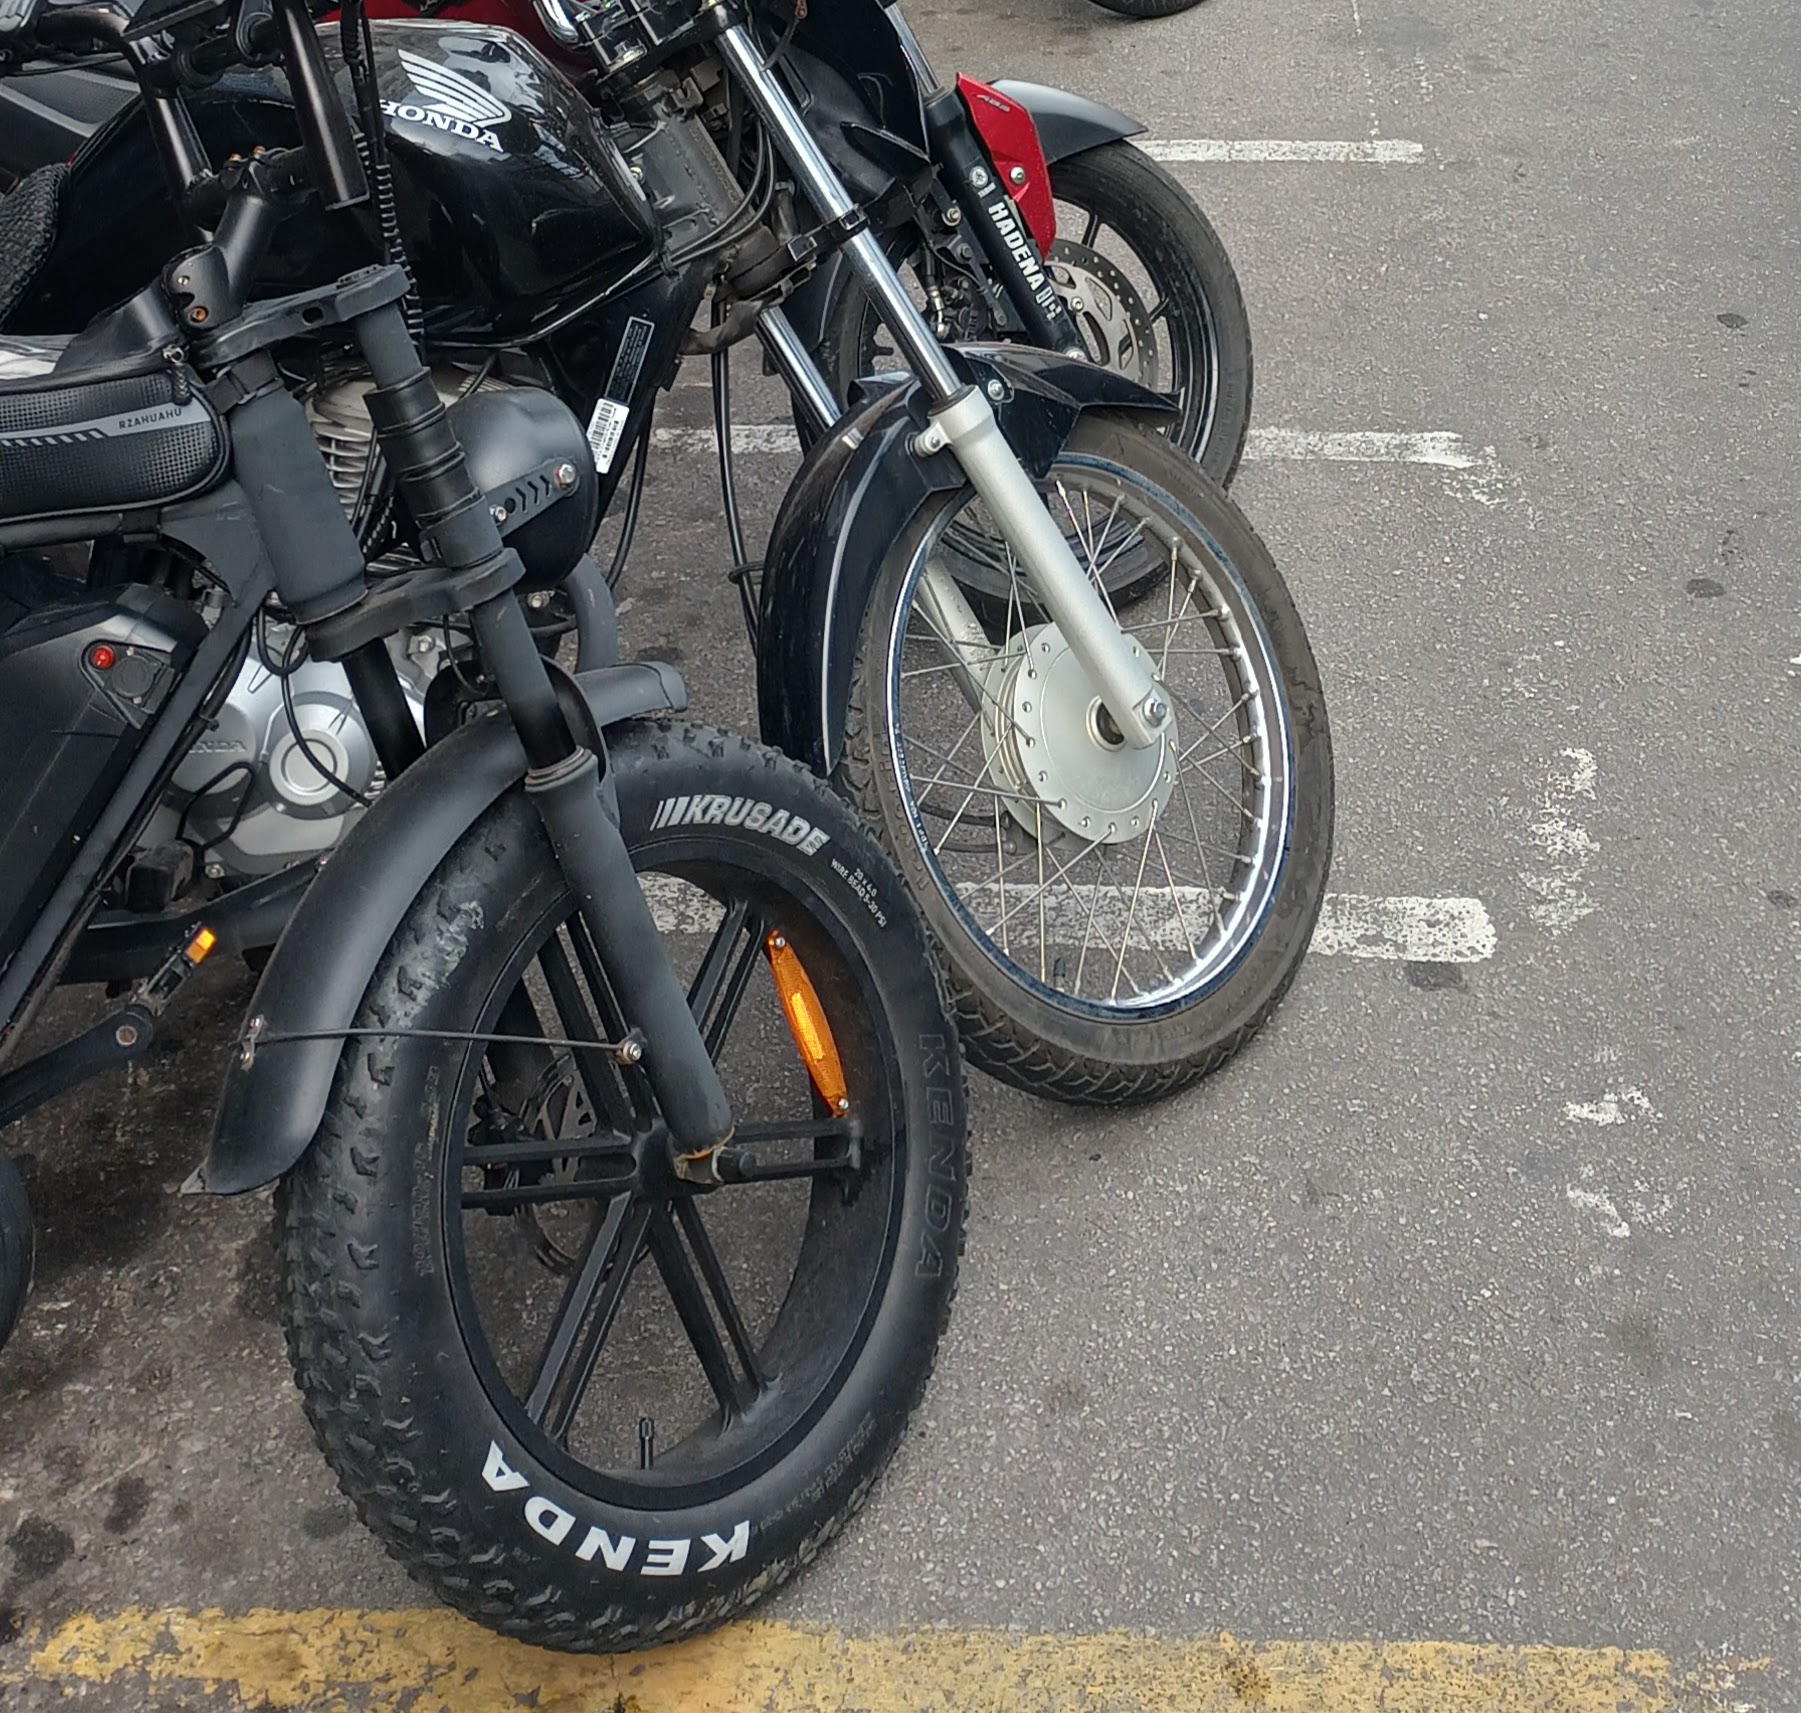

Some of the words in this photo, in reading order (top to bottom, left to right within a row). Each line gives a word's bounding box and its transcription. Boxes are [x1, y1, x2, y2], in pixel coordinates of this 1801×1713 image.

[379, 98, 504, 153] HONDA
[988, 201, 1042, 291] HADENA
[119, 408, 182, 429] RZAHUAHU
[680, 794, 831, 857] KRUSADE
[847, 875, 866, 897] BEAD
[874, 910, 887, 928] PSI
[914, 1034, 958, 1277] KENDA
[481, 1439, 750, 1576] KENDA
